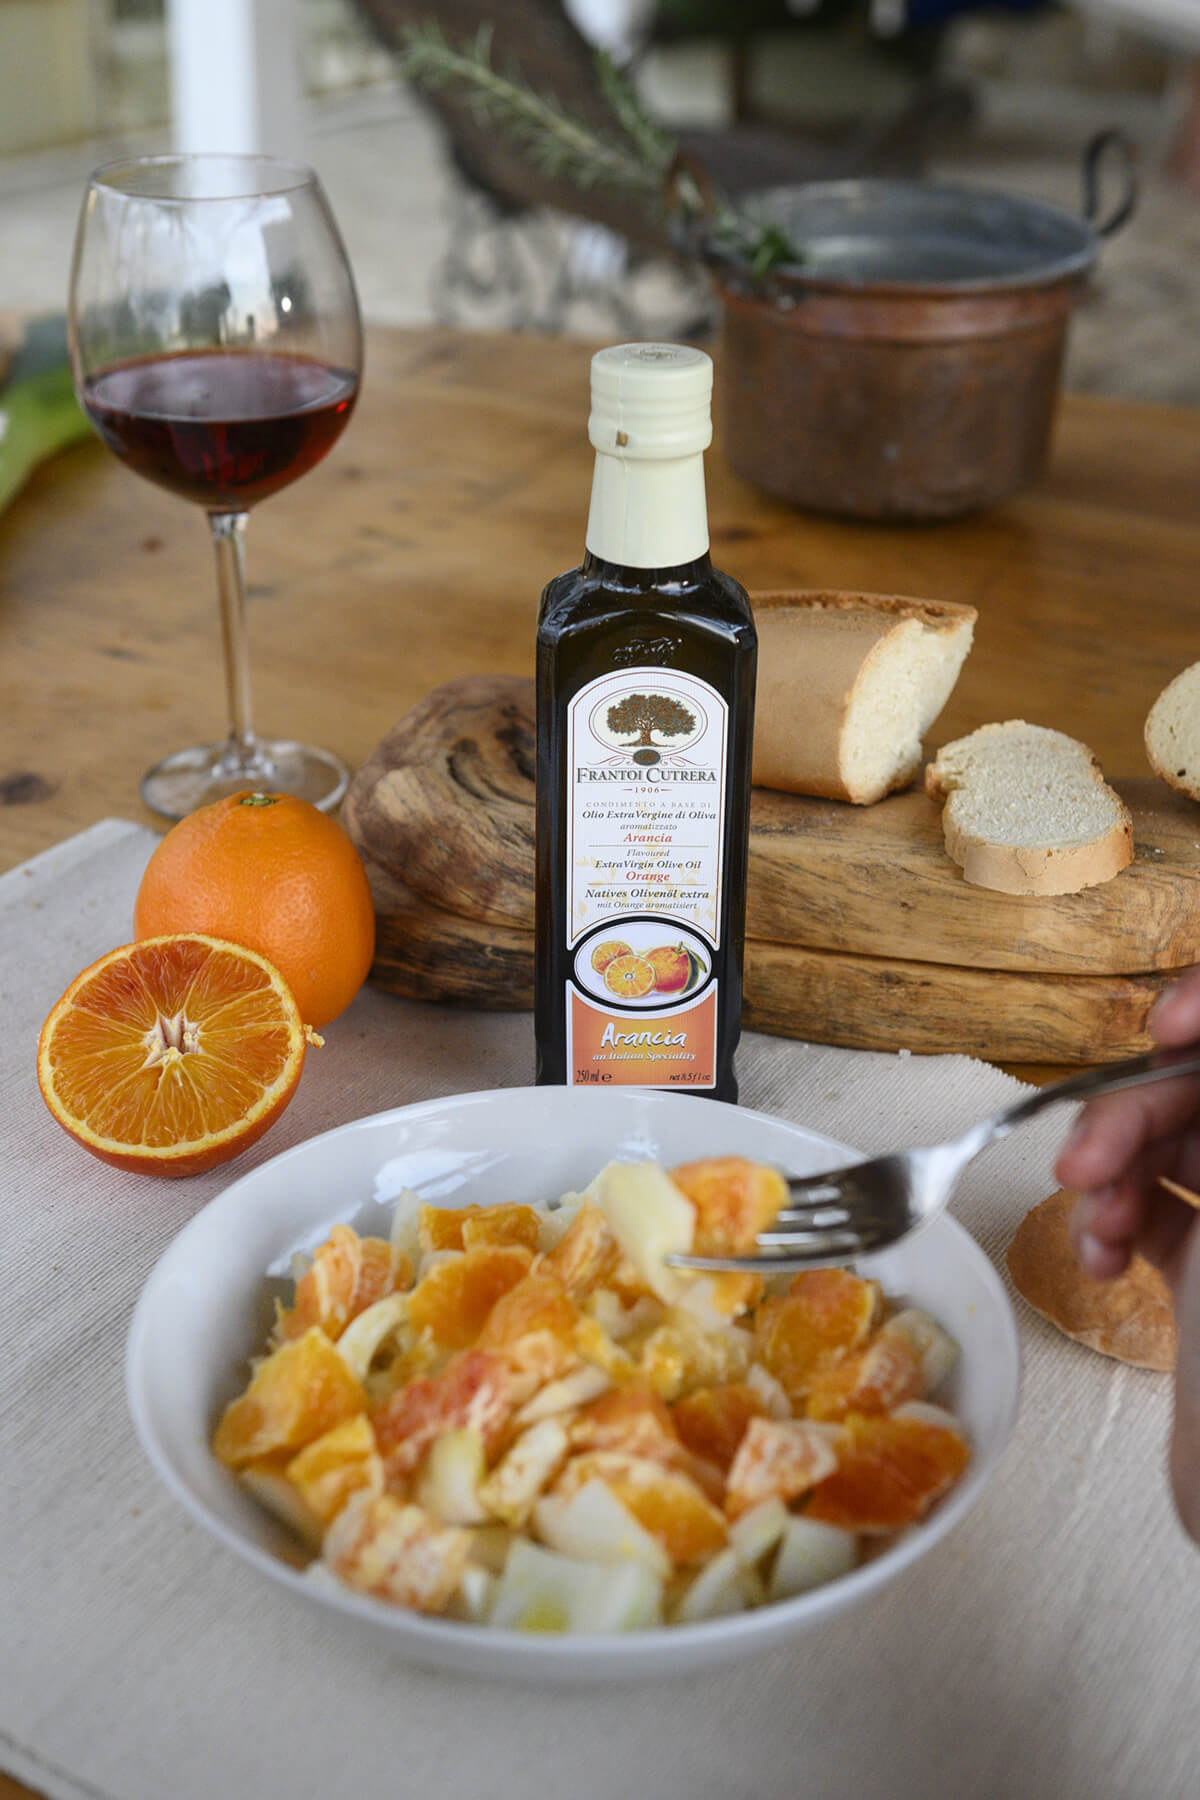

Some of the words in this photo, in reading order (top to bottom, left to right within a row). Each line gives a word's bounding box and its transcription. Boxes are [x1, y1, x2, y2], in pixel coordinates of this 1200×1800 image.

[577, 767, 641, 783] FRANTOI
[646, 767, 717, 783] CUTRERA
[582, 810, 604, 818] Olio
[675, 811, 685, 819] di
[688, 811, 716, 819] Oliva
[624, 832, 672, 843] Arancia
[656, 860, 682, 868] Olive
[685, 861, 701, 869] Oil
[626, 871, 670, 882] Orange
[585, 889, 627, 898] Natives
[630, 888, 677, 898] Olivenöl
[680, 890, 709, 898] extra
[614, 900, 643, 909] Orange
[601, 1022, 687, 1048] Arancia
[608, 1052, 644, 1060] Italian
[646, 1052, 696, 1062] Speciality
[576, 1070, 589, 1082] 250
[590, 1069, 599, 1082] ml
